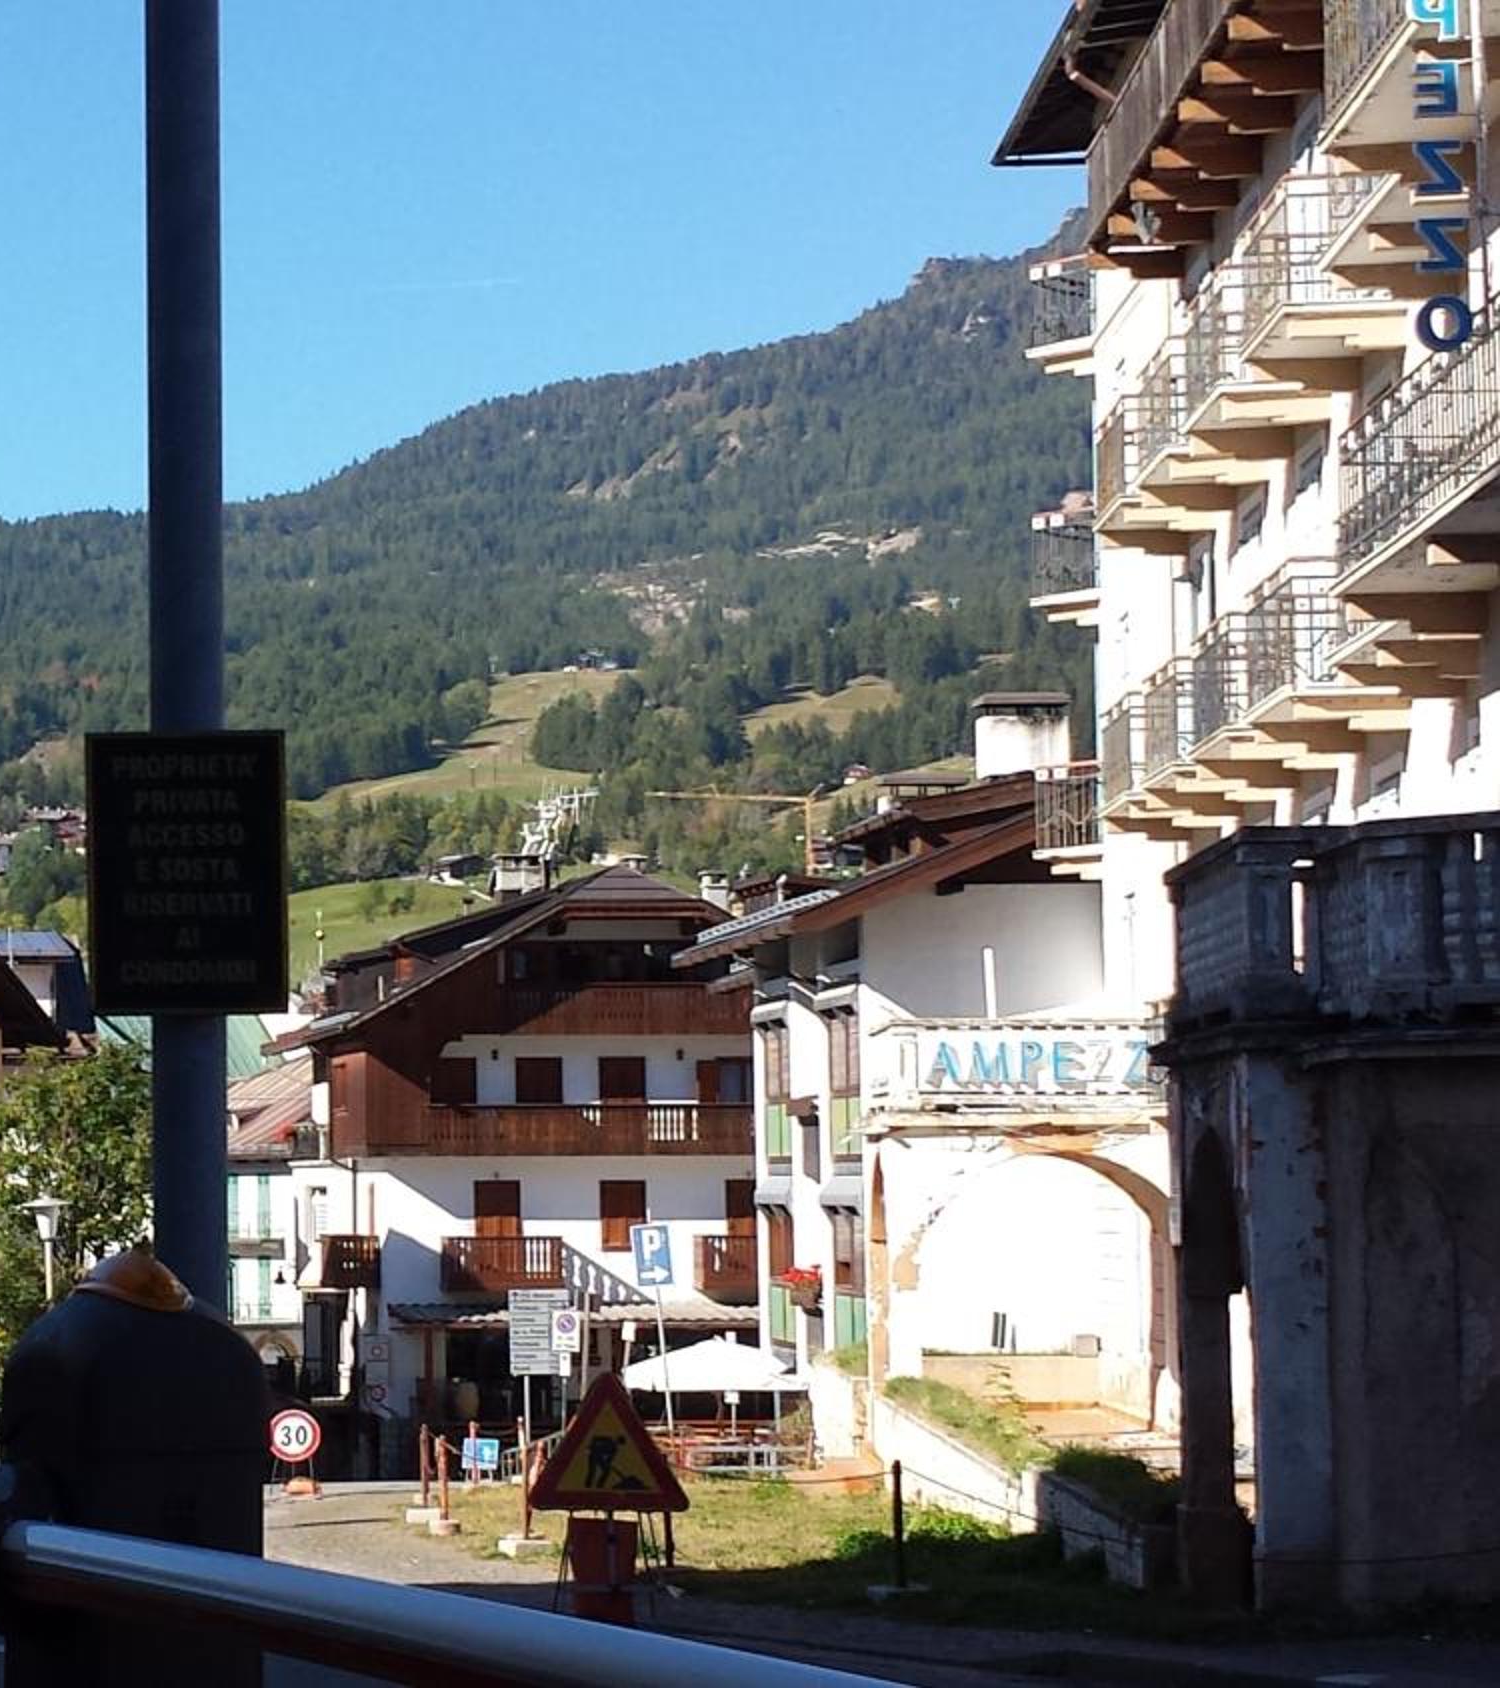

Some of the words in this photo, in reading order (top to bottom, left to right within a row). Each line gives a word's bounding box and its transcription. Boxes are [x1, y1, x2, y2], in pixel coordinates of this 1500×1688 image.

[132, 789, 240, 813] PRIVATA
[128, 823, 246, 848] ACCESSO
[135, 858, 152, 882] E
[158, 858, 240, 882] SOSTA
[123, 892, 253, 916] RISERVATI
[174, 928, 200, 949] AI
[120, 959, 259, 985] CONDOMINI
[927, 1040, 1148, 1087] AMPEZZ
[640, 1229, 662, 1265] P
[280, 1425, 308, 1447] 30
